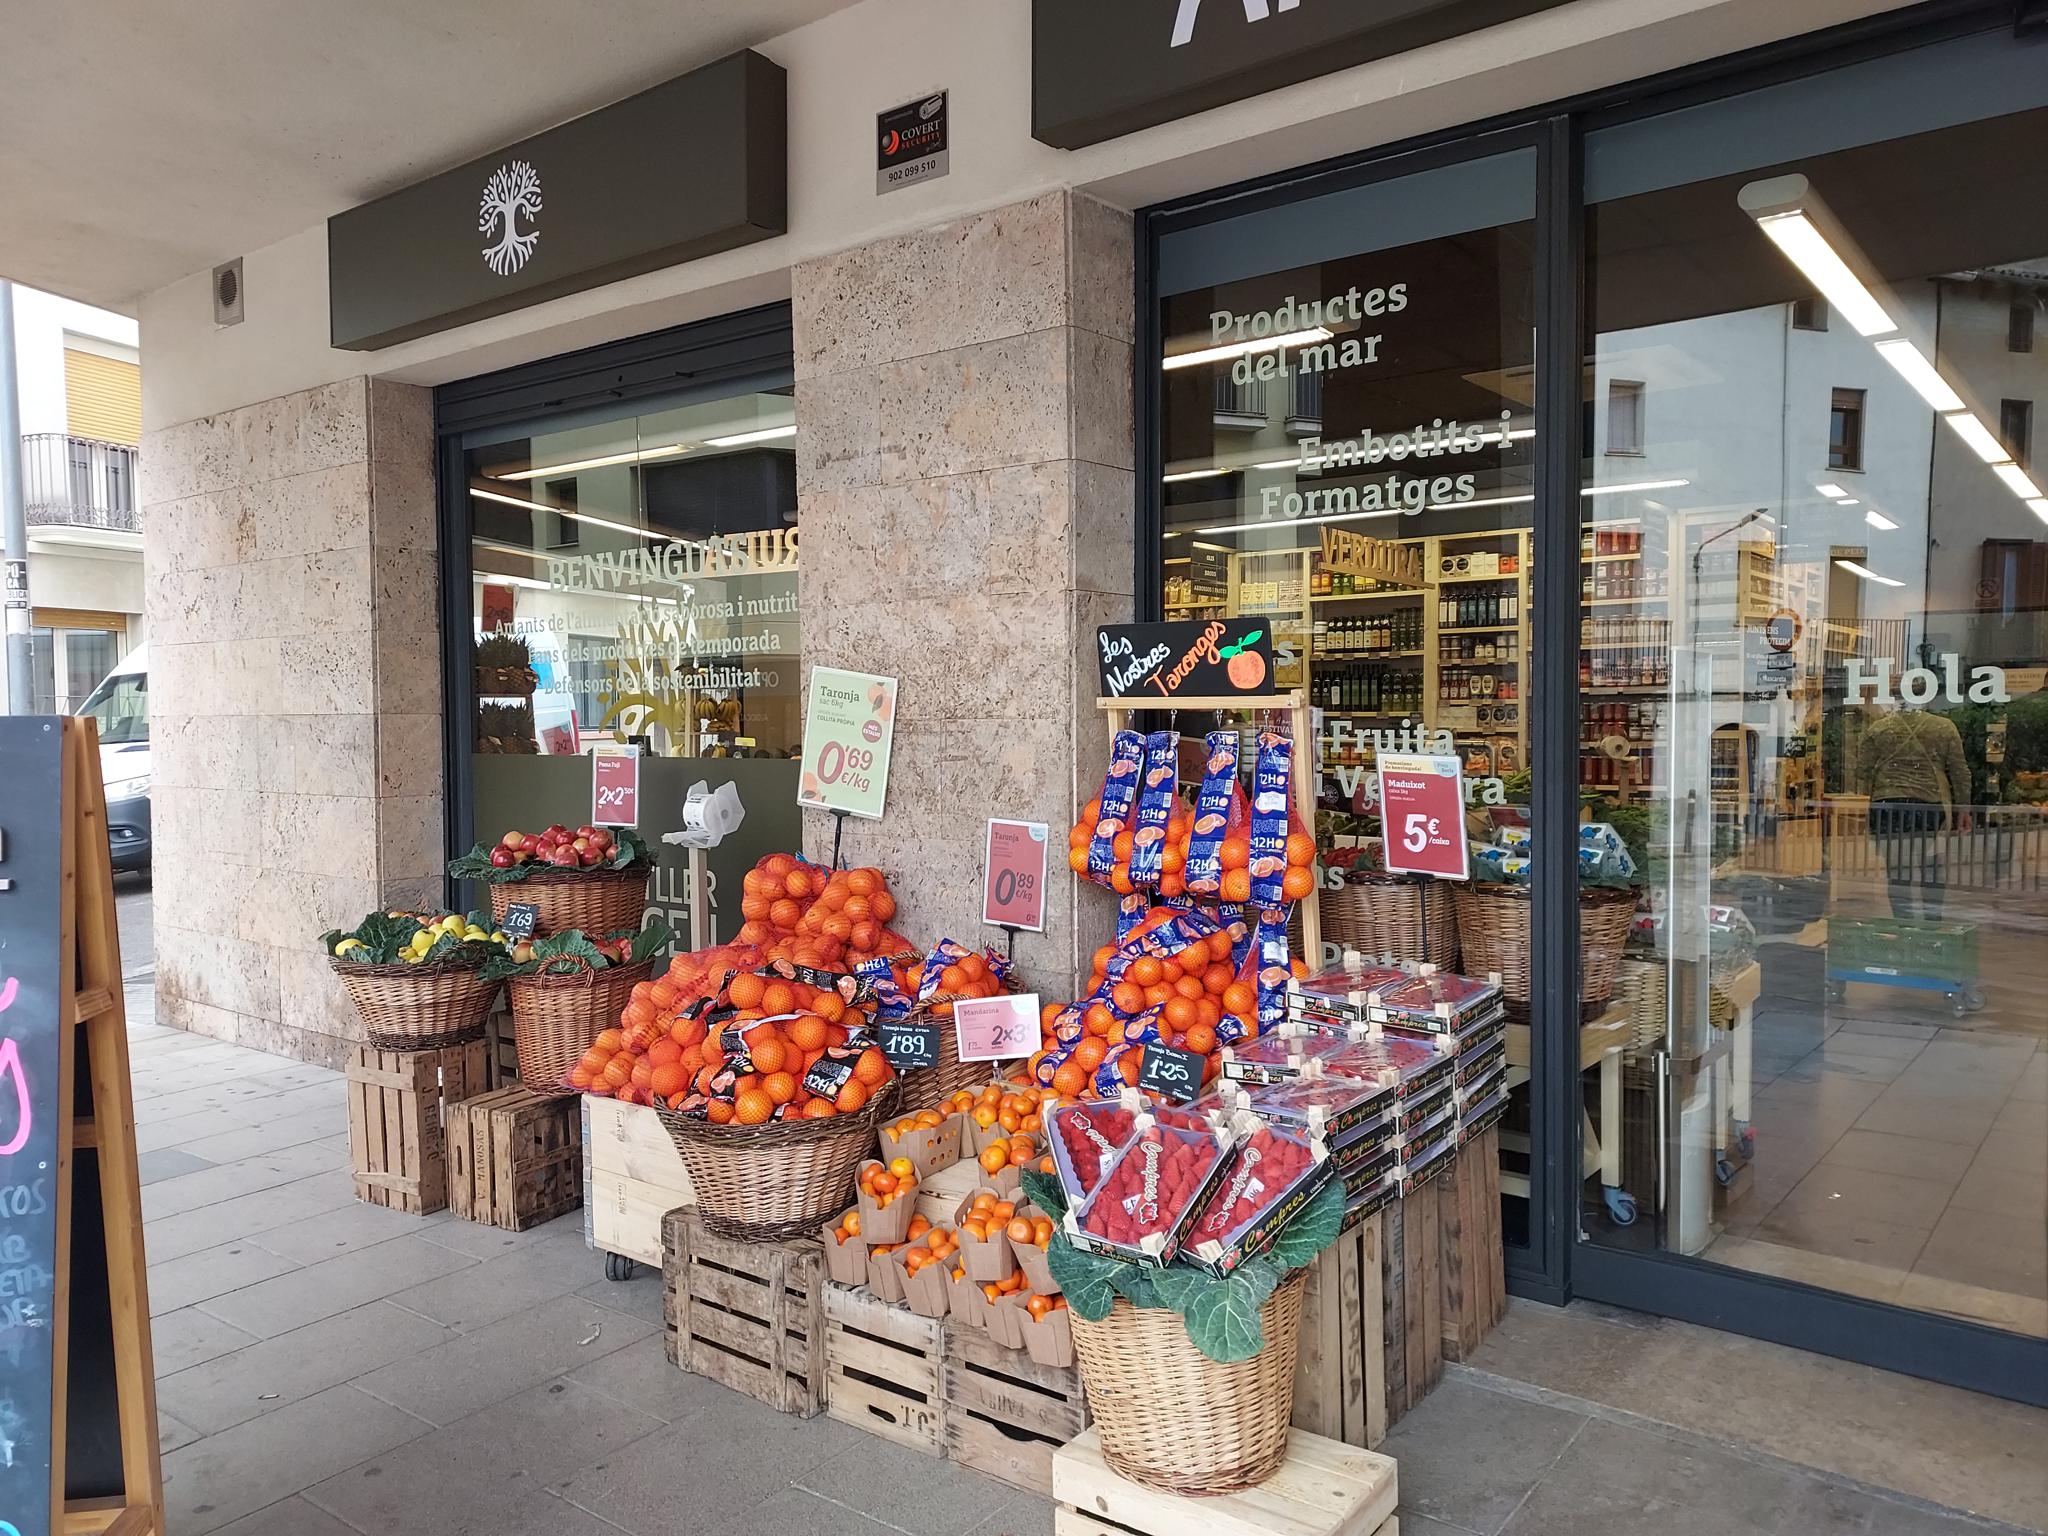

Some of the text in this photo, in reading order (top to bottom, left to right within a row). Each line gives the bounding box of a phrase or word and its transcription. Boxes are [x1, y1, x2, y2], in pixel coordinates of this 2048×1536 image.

[901, 119, 940, 141] COVERT
[901, 132, 941, 149] SECURITY
[888, 169, 903, 182] 902
[904, 165, 919, 178] 099
[921, 159, 936, 173] 510
[1209, 282, 1409, 346] Productes
[1231, 333, 1383, 386] del mar
[1297, 409, 1513, 473] Embotits i
[1259, 473, 1476, 516] Formatges
[1319, 525, 1421, 583] VERDURA
[495, 614, 545, 636] Amants
[548, 613, 564, 632] de
[664, 600, 734, 622] saborosa
[737, 595, 745, 617] i
[747, 590, 800, 616] nutrit
[562, 642, 590, 662] dels
[690, 629, 782, 657] temporada
[1099, 631, 1133, 664] Les
[1143, 621, 1226, 697] Taronges
[544, 675, 613, 695] Defensors
[654, 666, 761, 691] sostenibilitat
[1105, 642, 1171, 698] Nostres
[1843, 653, 2011, 705] Hola
[820, 685, 860, 704] Taronja
[816, 714, 836, 723] COLLITA
[1330, 718, 1457, 754] Fruita
[841, 771, 871, 793] €/kg
[1314, 763, 1326, 797] i
[1388, 779, 1426, 790] Maduixot
[1253, 836, 1276, 849] 12H
[963, 1007, 999, 1017] Mandarina
[885, 1034, 925, 1055] 1'89
[1146, 1058, 1189, 1081] 1'25
[1141, 1141, 1164, 1201] Campres
[1223, 1147, 1262, 1210] Campres
